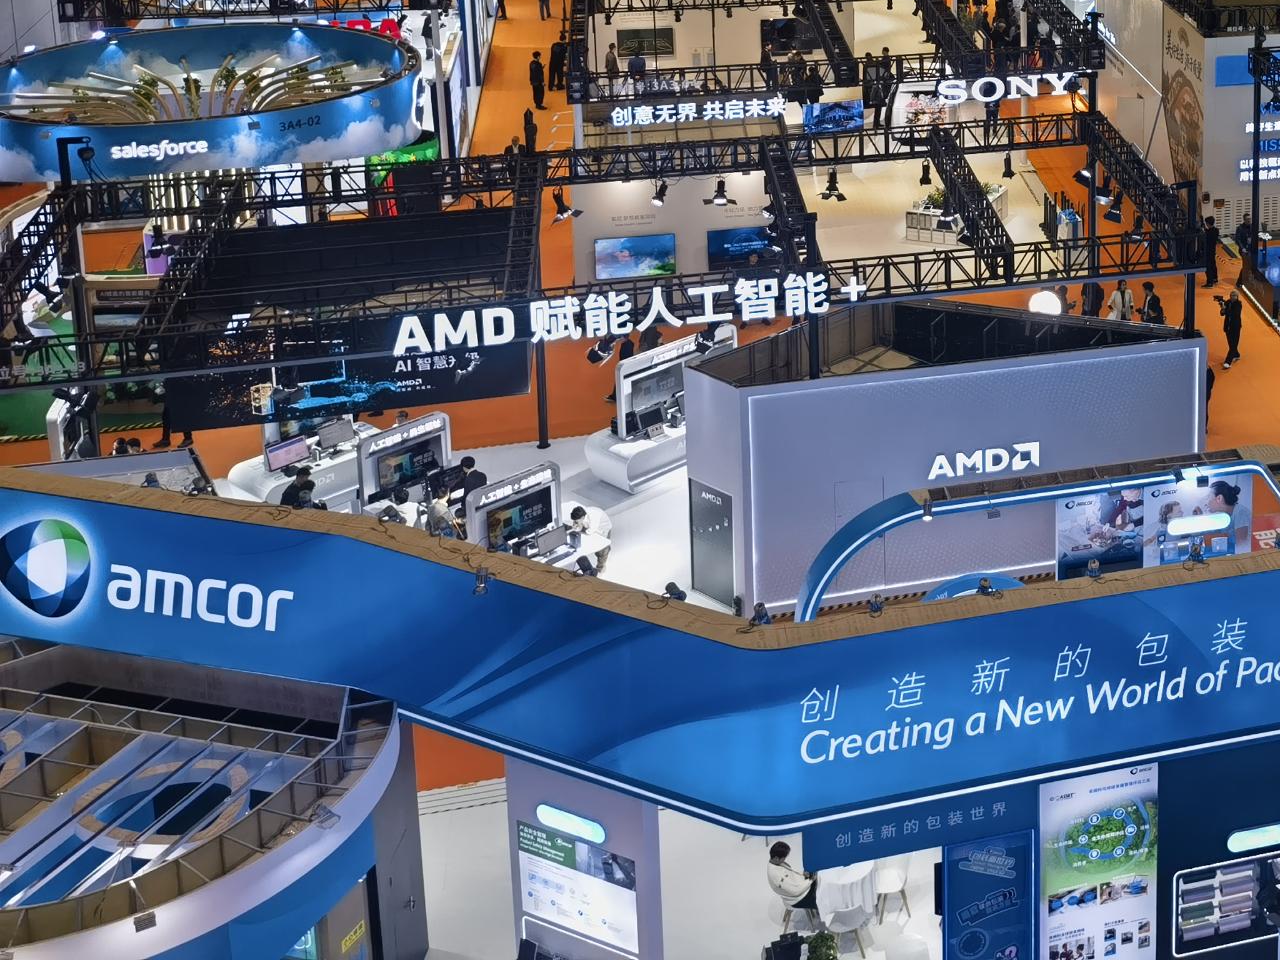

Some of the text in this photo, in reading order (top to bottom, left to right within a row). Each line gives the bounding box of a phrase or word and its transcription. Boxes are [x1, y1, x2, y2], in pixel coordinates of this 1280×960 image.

[937, 72, 1074, 105] SONY
[279, 115, 322, 132] 3A4-02
[611, 97, 787, 127] 创意无界 共启未来
[111, 139, 209, 161] salesforce
[393, 271, 867, 356] AMD 赋能人工智能 +
[395, 359, 411, 373] AI
[928, 449, 1010, 480] AMD
[107, 563, 294, 632] amcor
[799, 712, 950, 768] Creating
[965, 712, 985, 735] a
[995, 693, 1074, 732] New
[1086, 668, 1188, 712] World
[1195, 663, 1230, 695] of
[836, 802, 1008, 849] 创造新的包装世界
